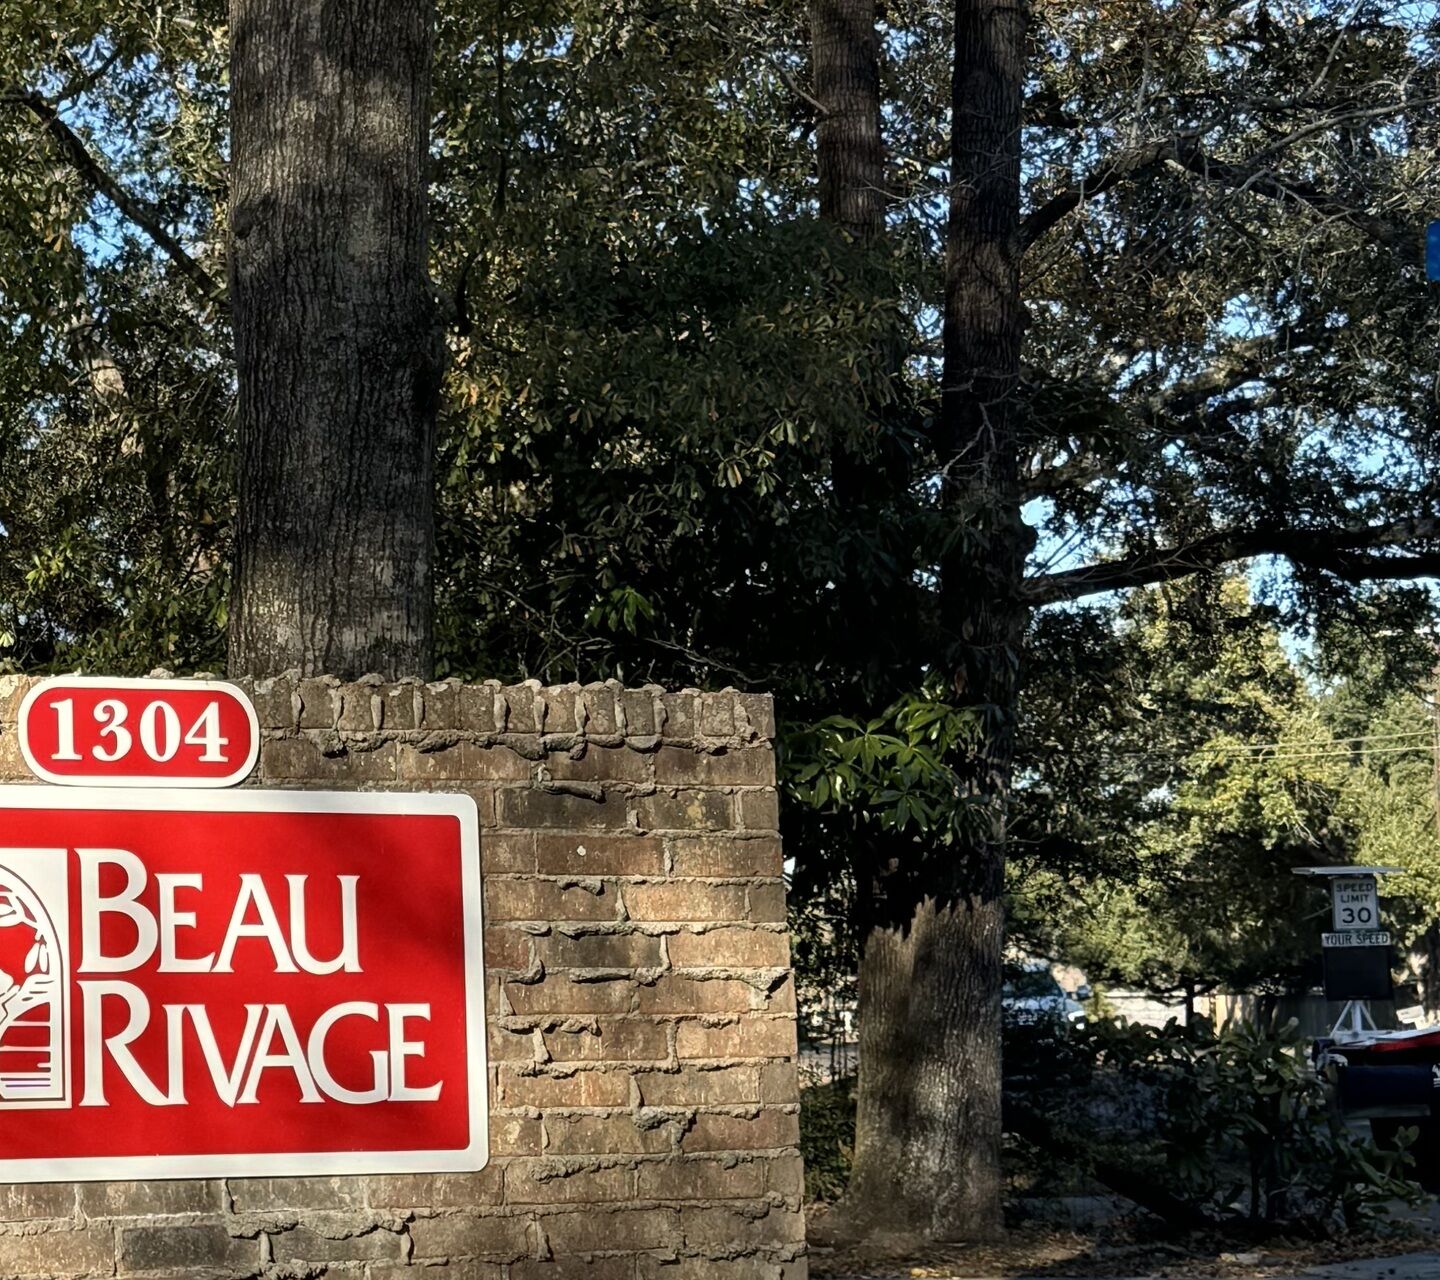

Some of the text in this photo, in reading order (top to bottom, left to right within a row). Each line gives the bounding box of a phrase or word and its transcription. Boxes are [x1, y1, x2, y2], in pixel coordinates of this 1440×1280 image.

[50, 699, 229, 763] 1304
[1336, 883, 1373, 892] SPEED
[1341, 894, 1369, 903] LIMIT
[74, 847, 364, 975] BEAU
[1342, 907, 1371, 923] 30
[1325, 934, 1388, 945] YOUR SPEED
[76, 980, 444, 1108] RIVAGE
